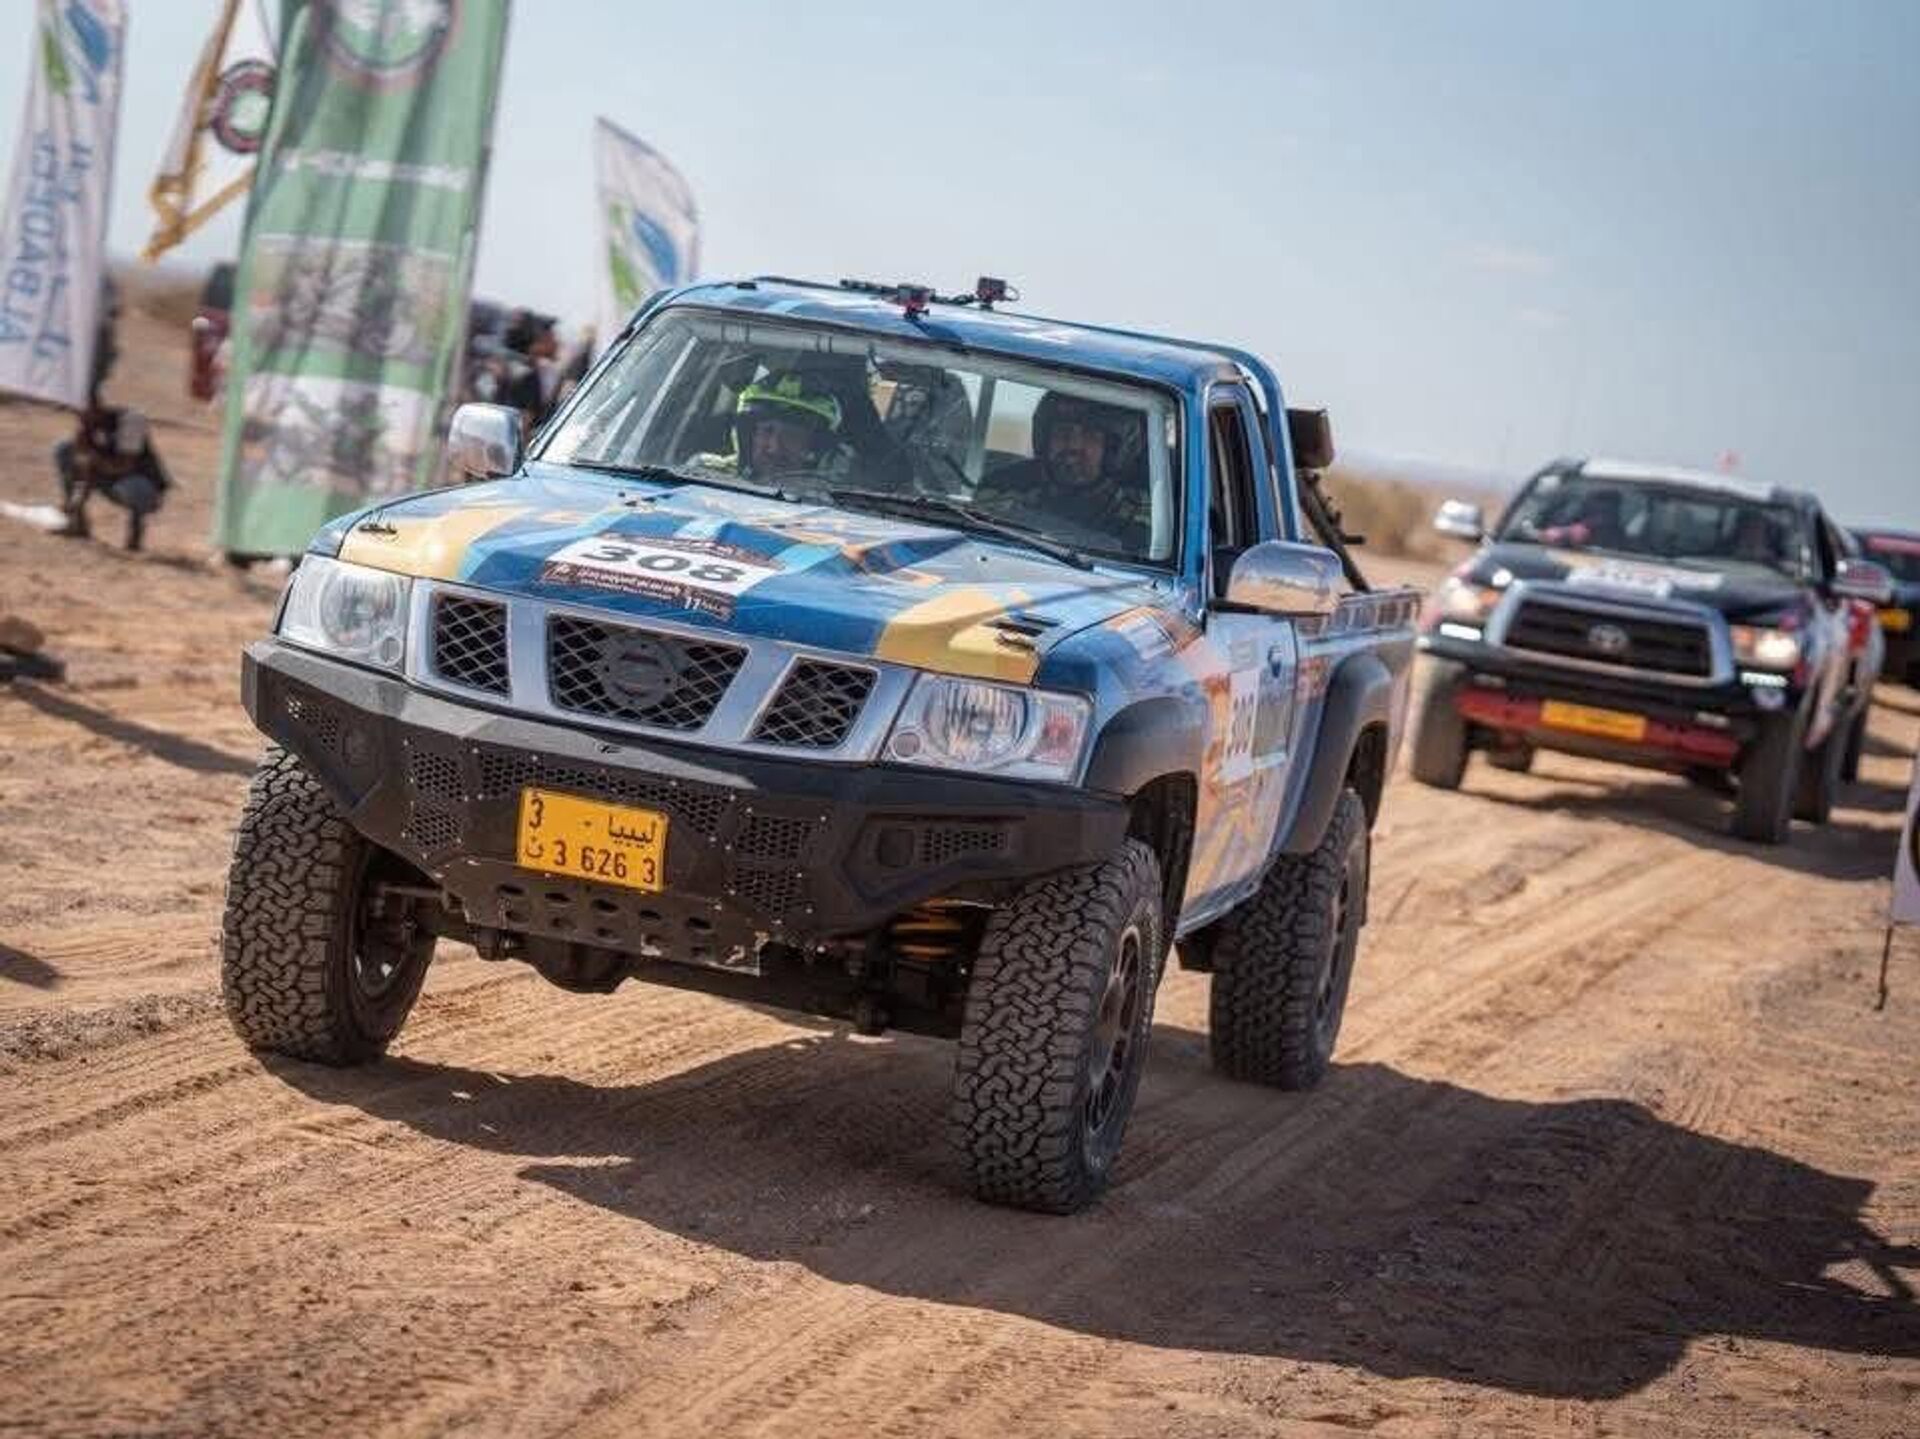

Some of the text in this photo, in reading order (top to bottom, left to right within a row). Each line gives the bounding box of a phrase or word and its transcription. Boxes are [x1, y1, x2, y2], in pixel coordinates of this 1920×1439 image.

[581, 545, 746, 583] 308
[529, 798, 544, 829] 3
[608, 813, 657, 850] ليبيا
[580, 846, 627, 879] 626
